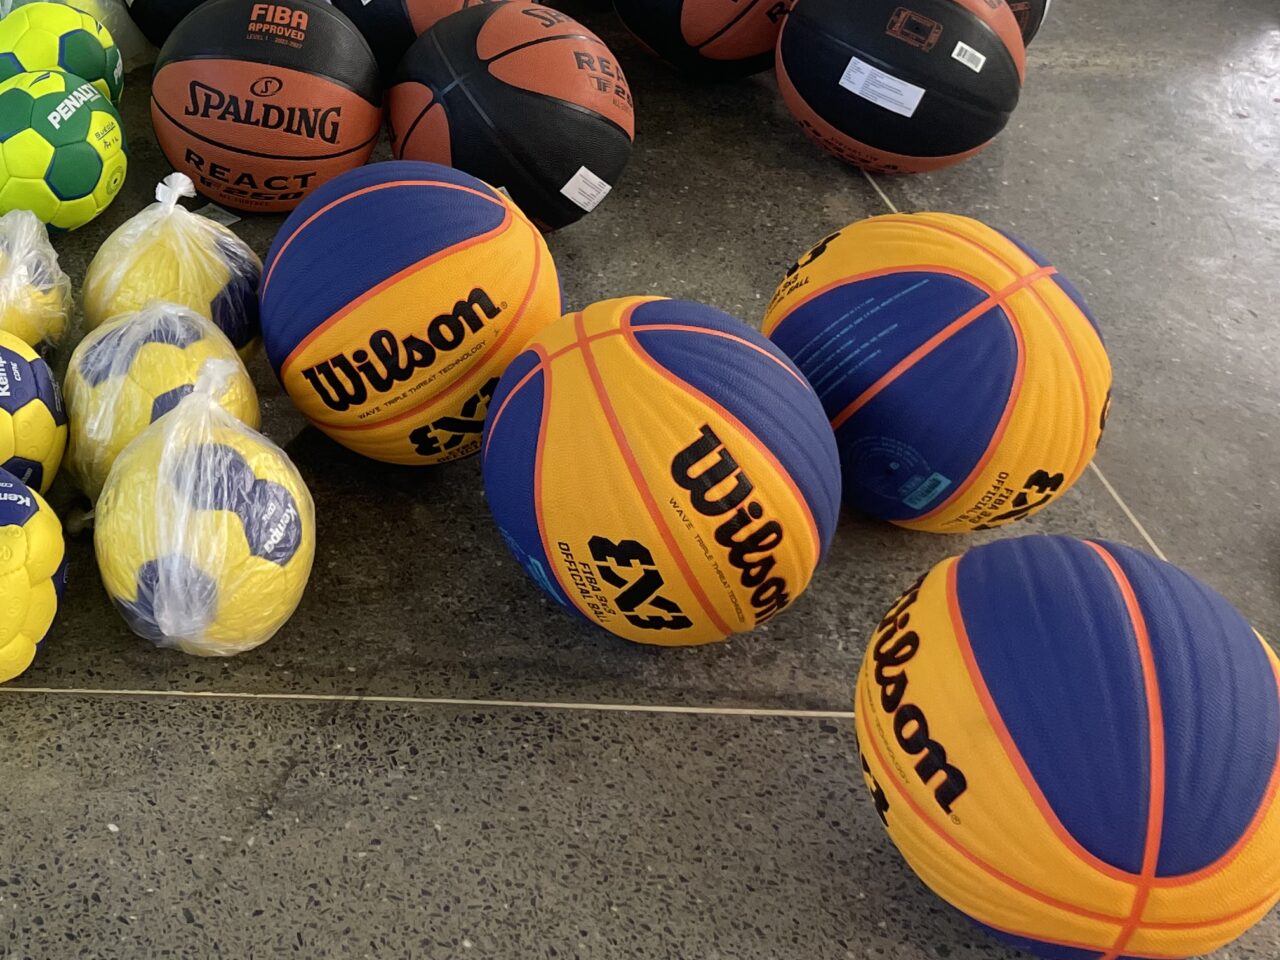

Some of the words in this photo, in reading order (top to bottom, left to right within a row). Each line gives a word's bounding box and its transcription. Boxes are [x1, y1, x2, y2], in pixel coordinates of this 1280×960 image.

[247, 22, 306, 41] APPROVED
[250, 3, 309, 31] FIBA
[184, 80, 342, 145] SPALDING
[184, 147, 317, 192] REACT
[13, 360, 23, 383] CORE
[301, 287, 502, 413] Wilson
[357, 406, 382, 420] WAVE
[383, 391, 408, 407] TRIPLE
[407, 373, 438, 394] THREAT
[438, 339, 488, 380] TECHNOLOGY
[970, 471, 1011, 516] OFFICIAL
[987, 487, 1014, 512] FIBA
[263, 503, 298, 554] Kempa
[669, 420, 792, 626] Wilson
[669, 496, 695, 531] WAVE
[693, 533, 714, 563] TRIPLE
[711, 561, 731, 590] THREAT
[556, 541, 593, 604] OFFICIAL
[586, 601, 610, 624] BALL
[578, 561, 603, 598] FIBA
